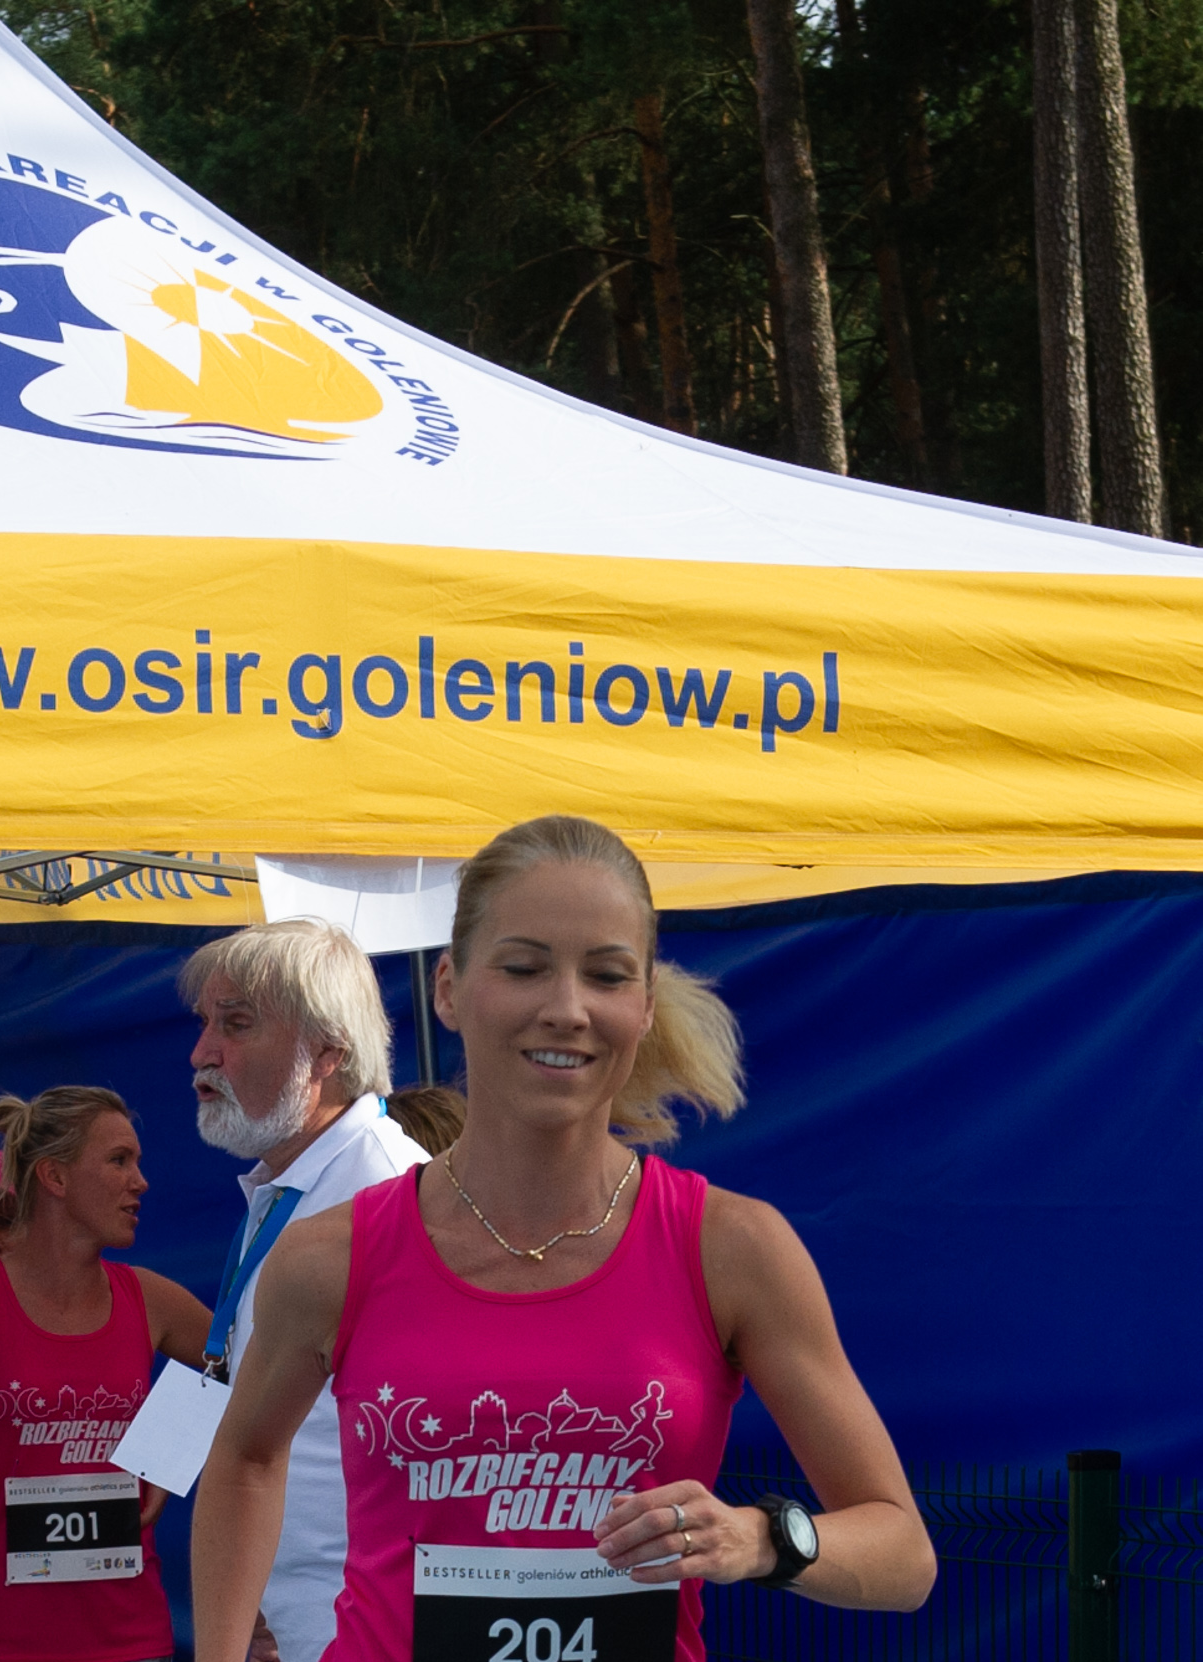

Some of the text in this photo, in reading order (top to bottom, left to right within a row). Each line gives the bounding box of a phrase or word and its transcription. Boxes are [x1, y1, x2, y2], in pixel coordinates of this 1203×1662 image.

[311, 314, 460, 466] GOLENIOWIE
[9, 1487, 56, 1496] BESTSELLER
[119, 1481, 136, 1490] park
[45, 1511, 98, 1543] 201
[423, 1565, 637, 1584] BESTSELLER goleniów athletic
